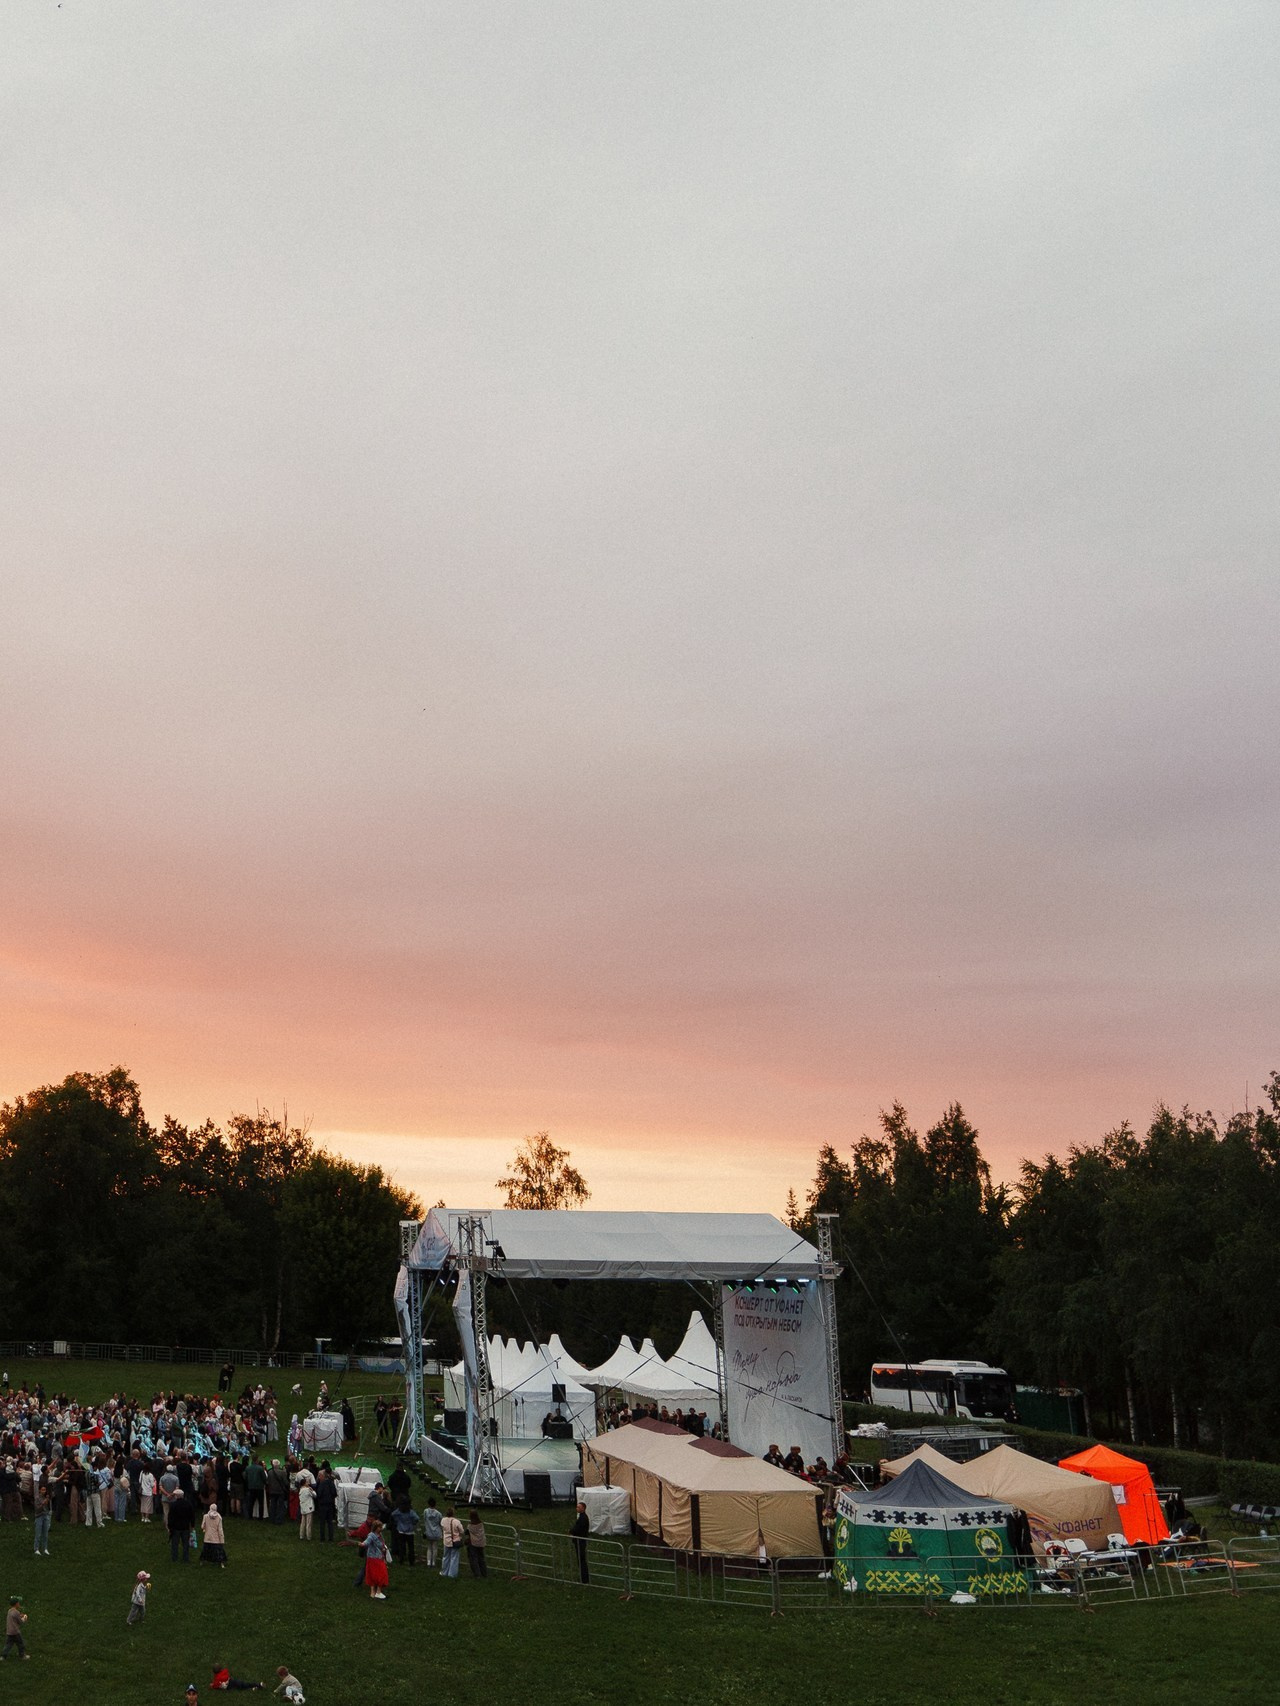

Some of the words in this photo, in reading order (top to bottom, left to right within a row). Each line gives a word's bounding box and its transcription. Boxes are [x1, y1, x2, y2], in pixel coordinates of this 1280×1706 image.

[735, 1295, 764, 1311] КОНЦЕРТ
[764, 1298, 775, 1312] ОТ
[774, 1299, 804, 1315] УФАНЕТ
[734, 1314, 745, 1327] ПОД
[745, 1315, 778, 1330] ОТКРЫТЫМ
[778, 1318, 802, 1333] НЕБОМ
